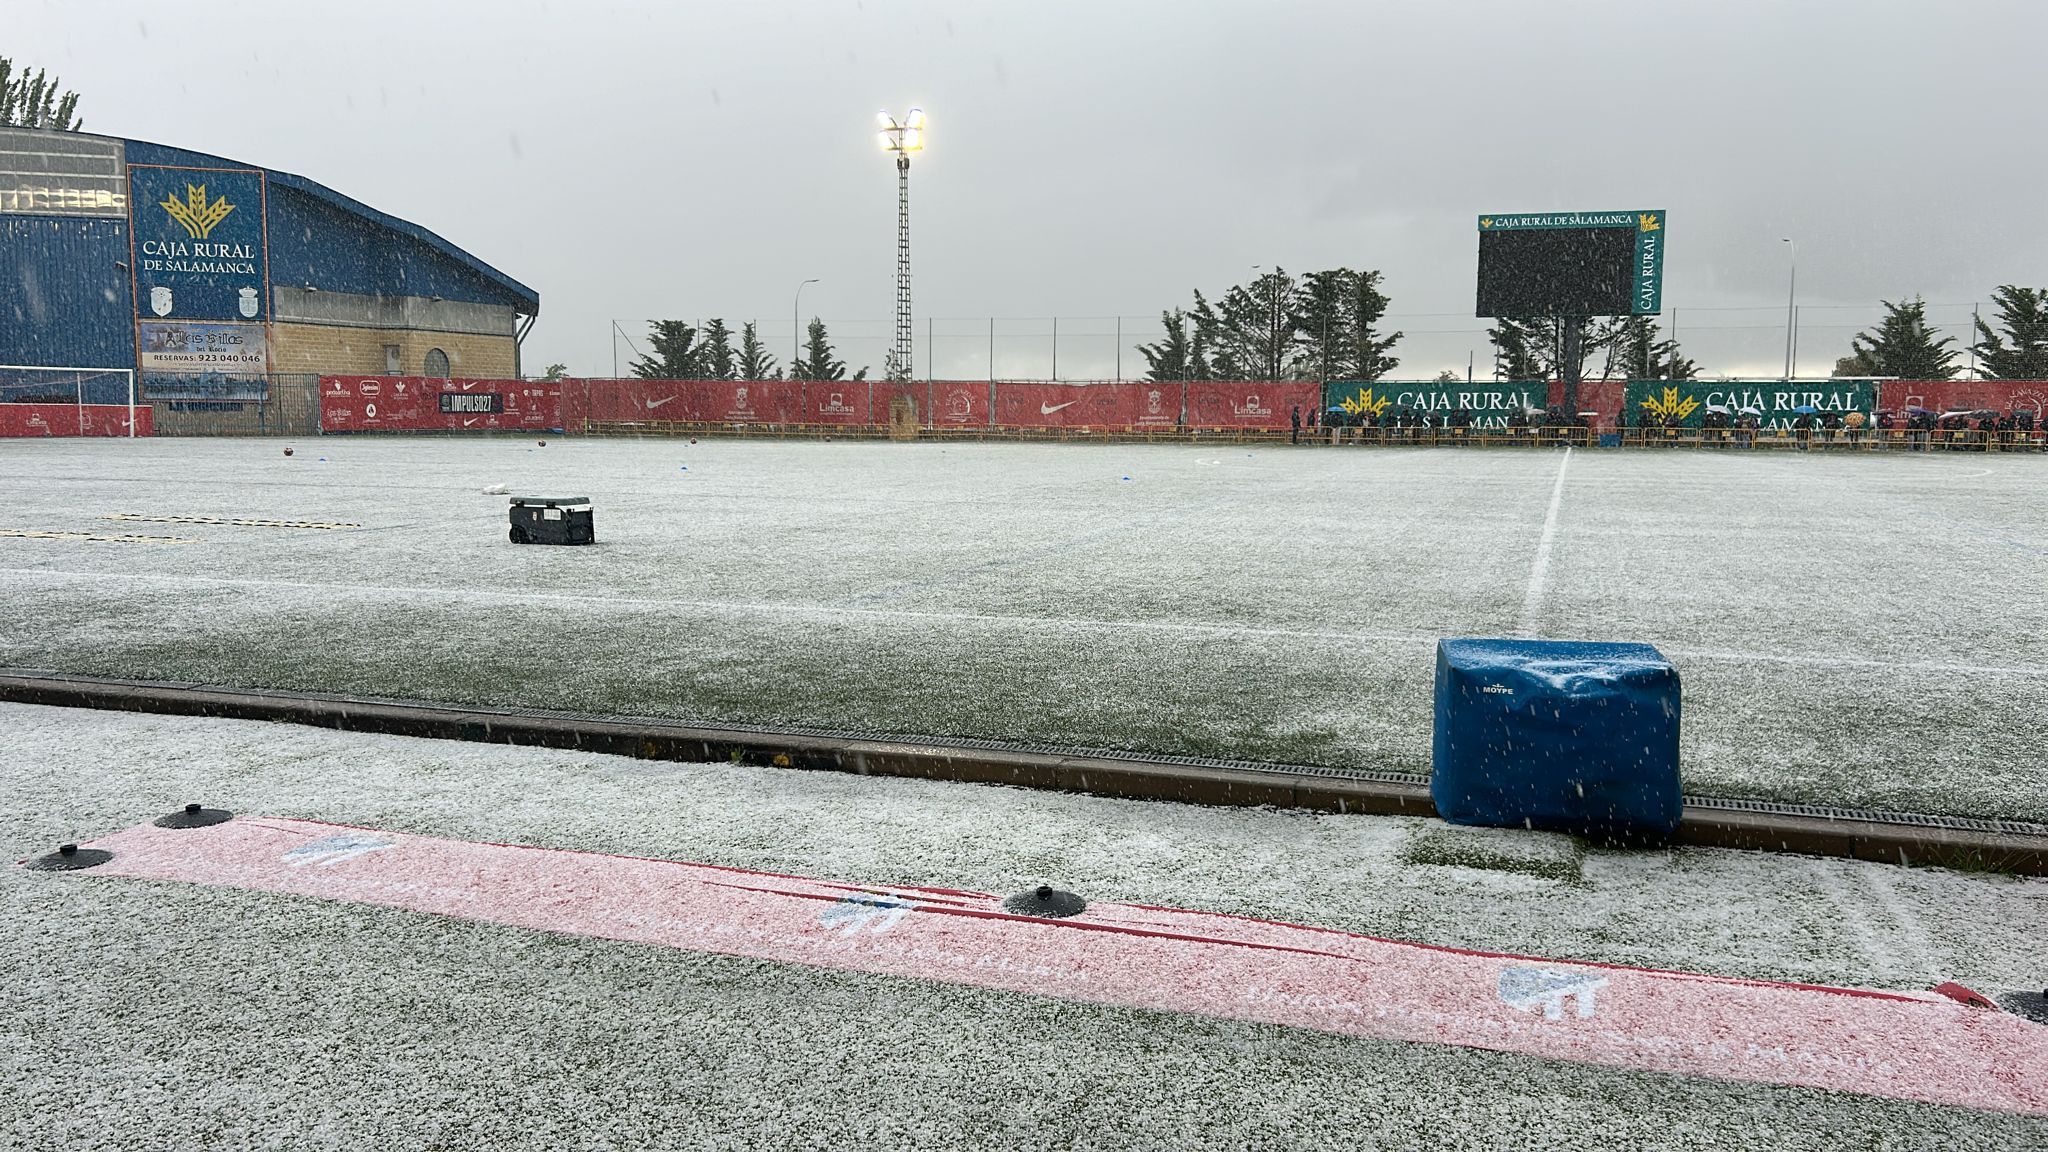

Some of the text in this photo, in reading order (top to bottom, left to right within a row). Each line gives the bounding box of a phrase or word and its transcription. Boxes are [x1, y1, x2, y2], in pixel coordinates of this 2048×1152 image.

[1496, 215, 1632, 228] CAJA RURAL DE SALAMANCA
[143, 240, 255, 260] CAJA RURAL
[144, 260, 256, 274] DE SALAMANCA
[1641, 236, 1655, 310] CAJA RURAL
[198, 354, 217, 362] 923
[241, 355, 260, 363] 046
[451, 394, 492, 412] IMPULSO27
[820, 402, 854, 413] Limcasa
[1397, 392, 1534, 411] CAJA RURAL
[1773, 392, 1859, 410] RURAL
[1235, 404, 1272, 414] Limcasa
[1483, 686, 1514, 695] MOYPE
